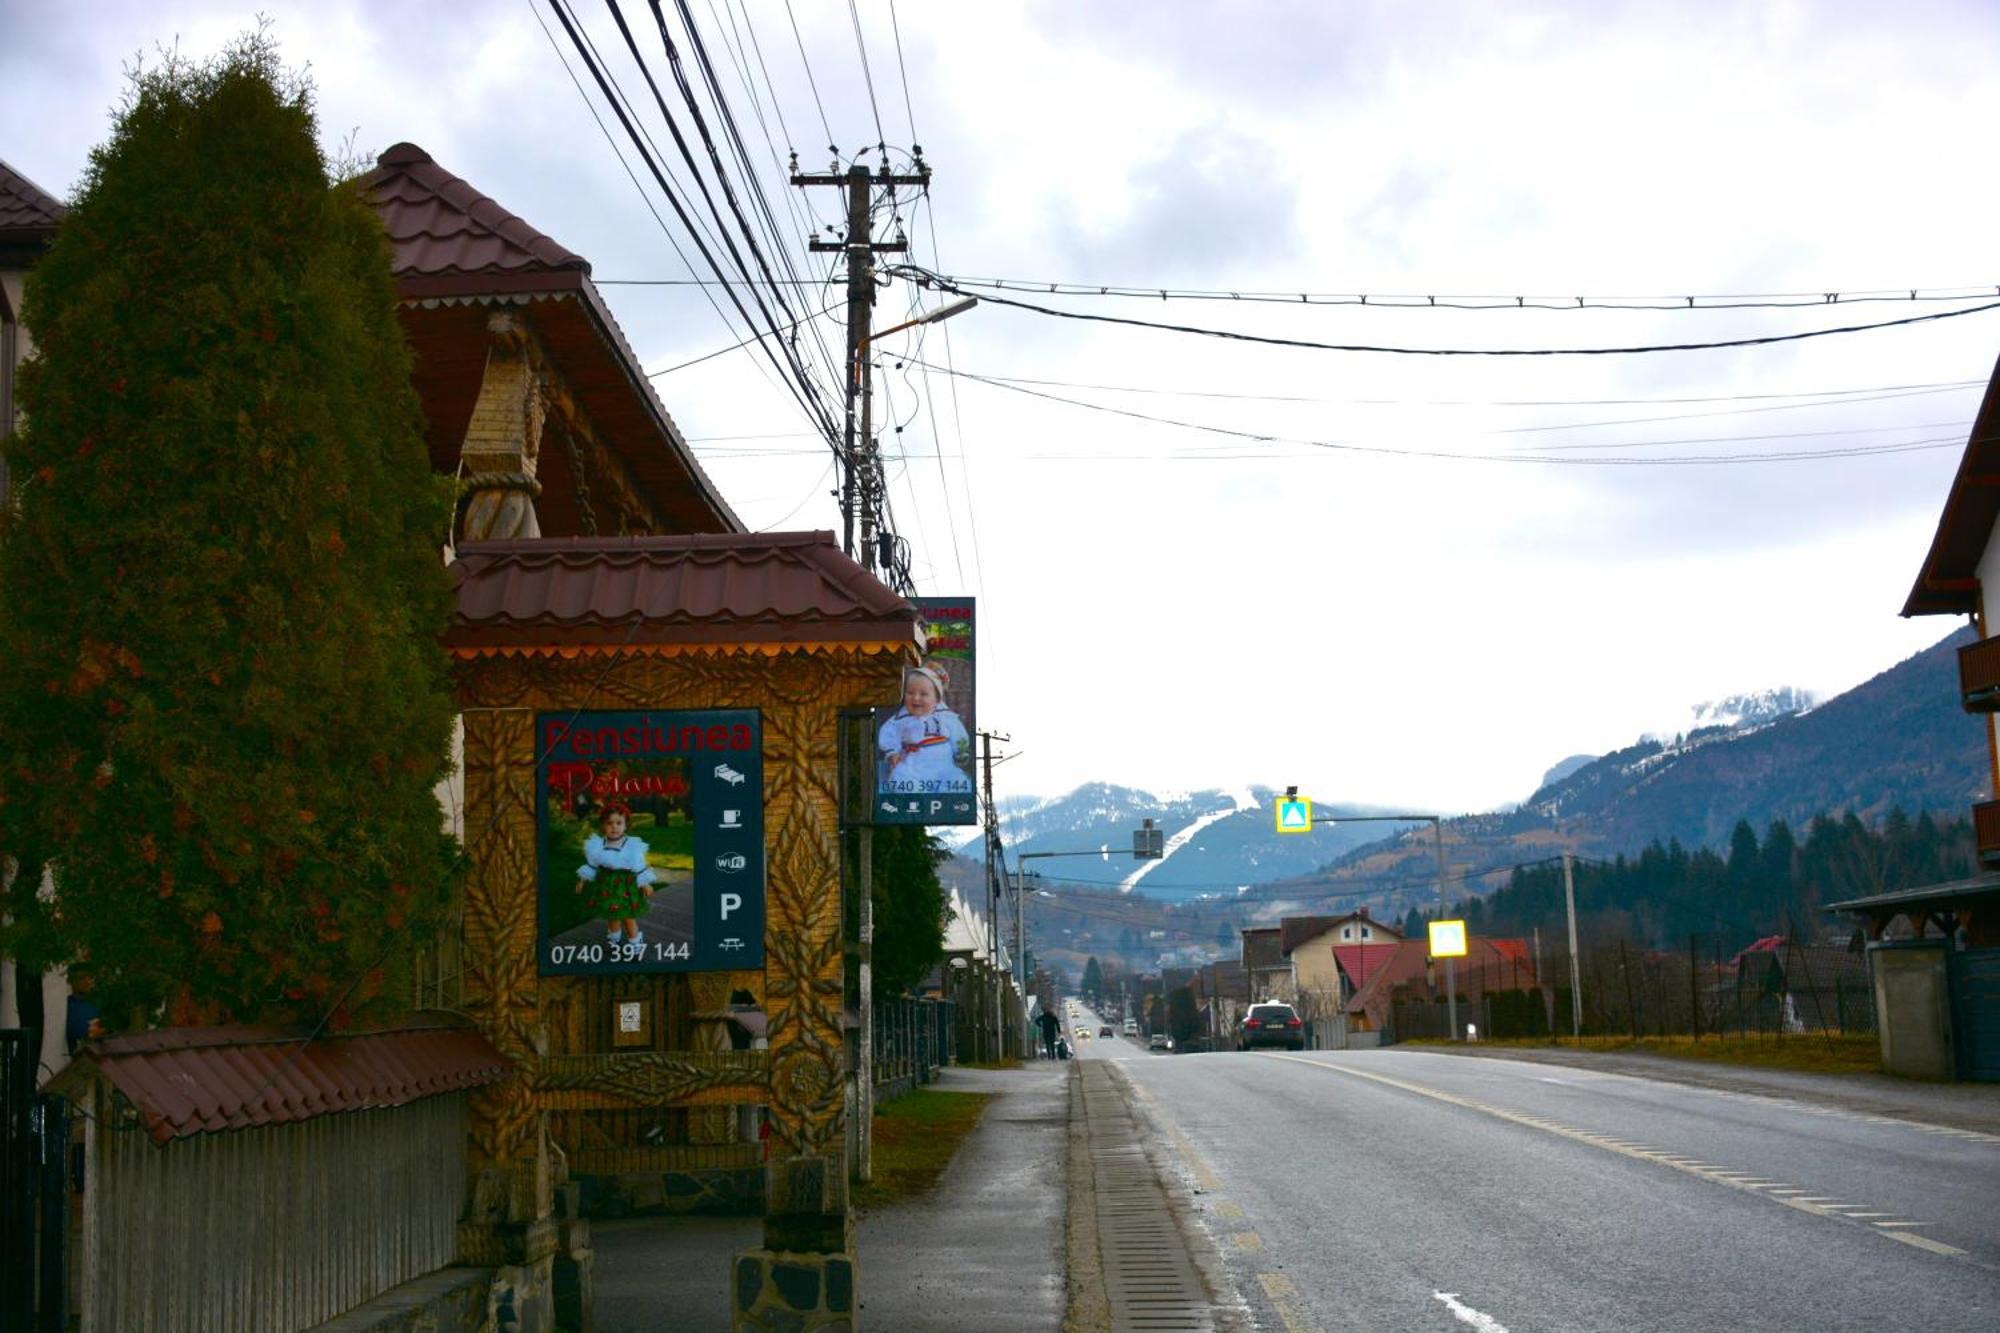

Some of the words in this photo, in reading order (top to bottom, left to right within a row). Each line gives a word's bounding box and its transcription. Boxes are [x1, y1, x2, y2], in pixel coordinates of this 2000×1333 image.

[544, 714, 753, 756] Pensiunea
[881, 780, 913, 792] 0740
[918, 780, 941, 792] 397
[946, 780, 968, 791] 144
[930, 800, 942, 815] P
[720, 893, 742, 920] P
[551, 944, 603, 965] 0740
[609, 943, 648, 963] 397
[654, 942, 691, 961] 144
